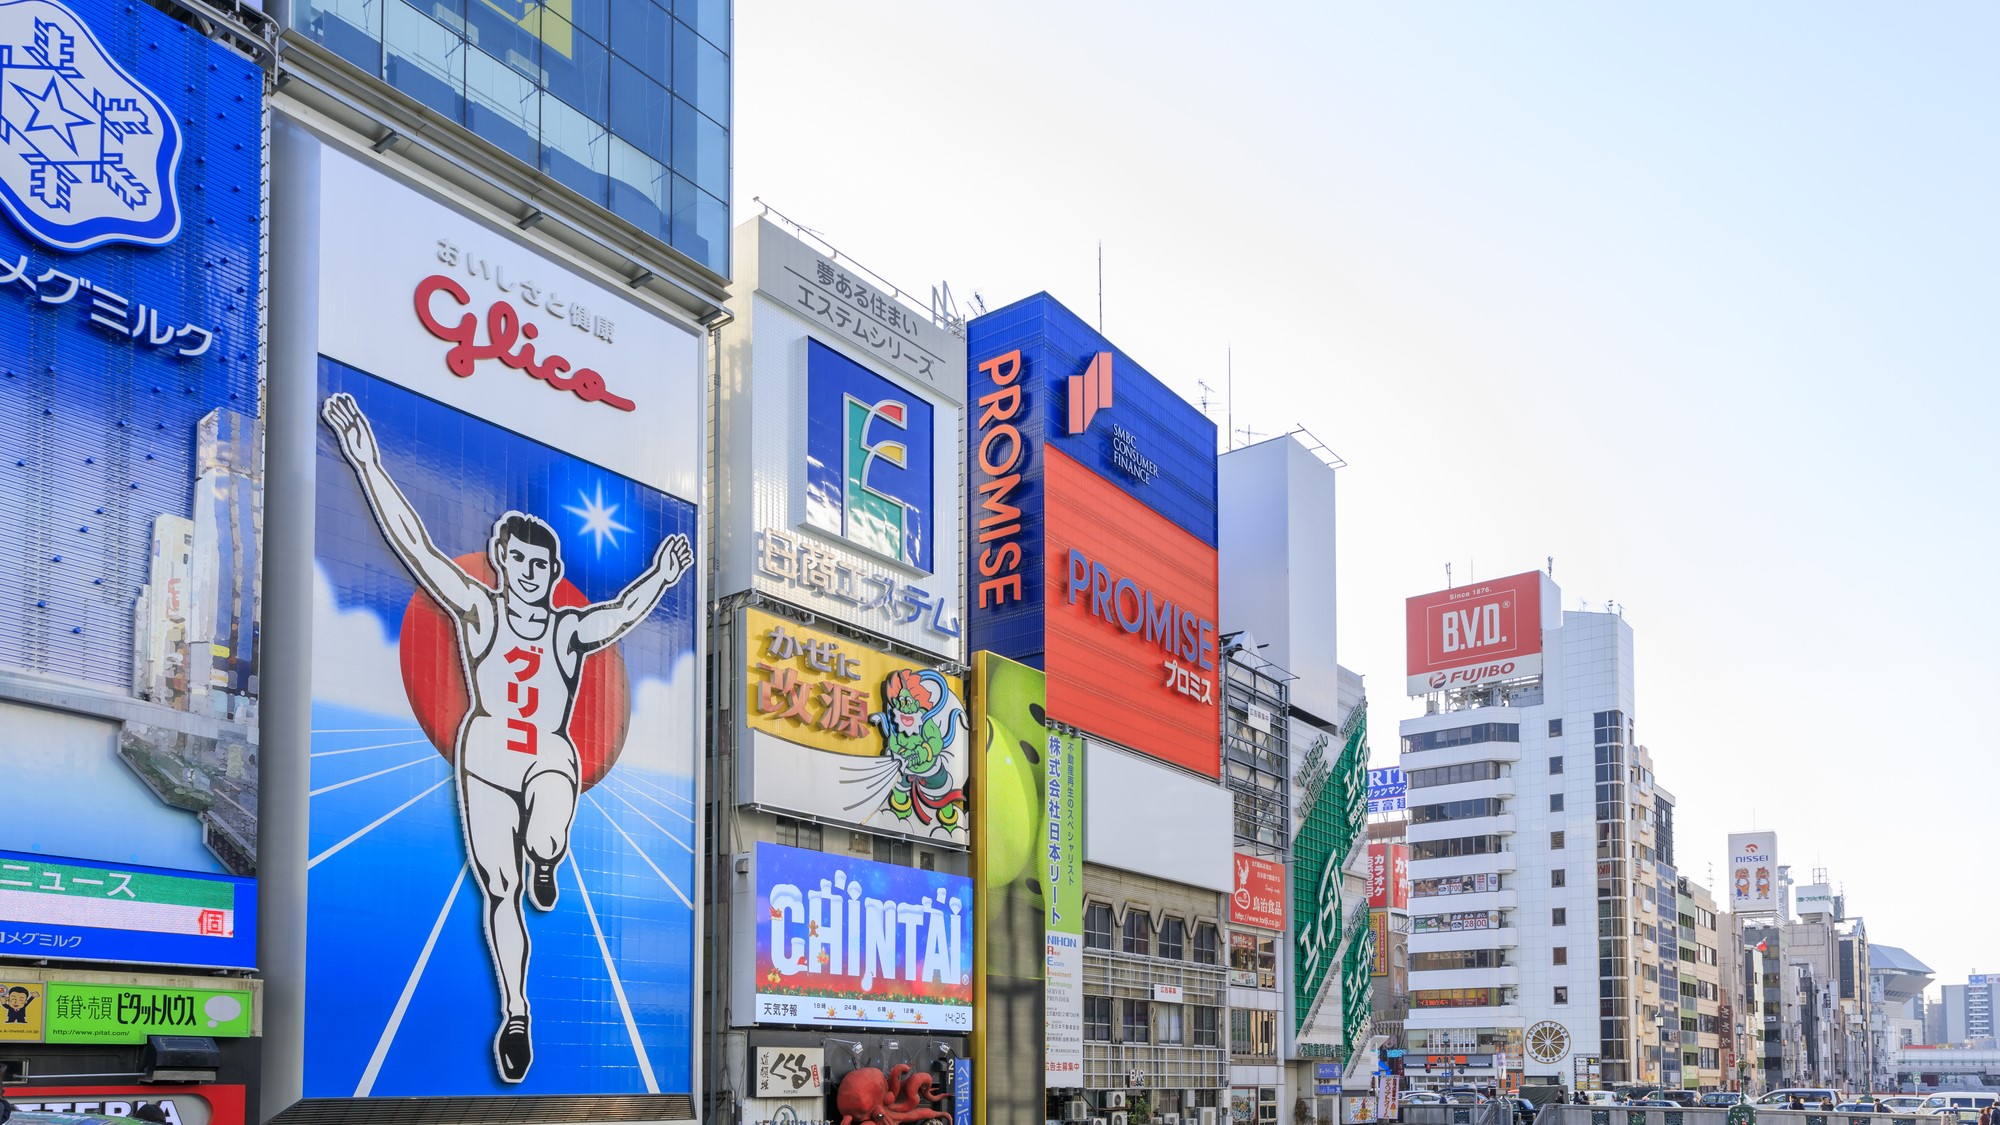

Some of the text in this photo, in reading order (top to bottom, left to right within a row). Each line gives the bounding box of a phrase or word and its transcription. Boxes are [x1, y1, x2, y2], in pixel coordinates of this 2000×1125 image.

[0, 254, 213, 357] メグミルク
[437, 238, 616, 344] おいしさと健康
[817, 259, 918, 336] 夢ある住まい
[414, 275, 636, 412] Glico
[797, 284, 934, 381] エステムシリーズ
[1113, 423, 1137, 449] SMBC
[1113, 437, 1159, 479] CONSUMER
[978, 349, 1022, 609] PROMISE
[1113, 450, 1150, 485] FINANCE
[763, 527, 960, 638] 日商エステム
[1449, 586, 1492, 601] Since 1876.
[1068, 547, 1214, 671] PROMISE
[1442, 602, 1507, 653] B.V.D.
[767, 625, 861, 681] かぜに
[1450, 662, 1515, 684] FUJIBO
[503, 645, 544, 755] グリコ
[756, 662, 871, 738] 改源
[1164, 660, 1213, 705] プロミス
[1048, 735, 1062, 926] 株式会社日本リート
[1374, 854, 1385, 897] カラオケ
[1735, 855, 1769, 863] NISSEI
[0, 864, 136, 899] ニュース
[198, 908, 225, 936] 個
[1299, 865, 1345, 972] エイブル
[1047, 935, 1077, 948] NIHON
[56, 992, 197, 1026] 賃貸・売買 ピタットハウス
[763, 1002, 798, 1017] 天気予報
[945, 1012, 967, 1025] 14:25
[53, 1029, 130, 1037] http://www.pitat.com/
[769, 1053, 811, 1089] くくる
